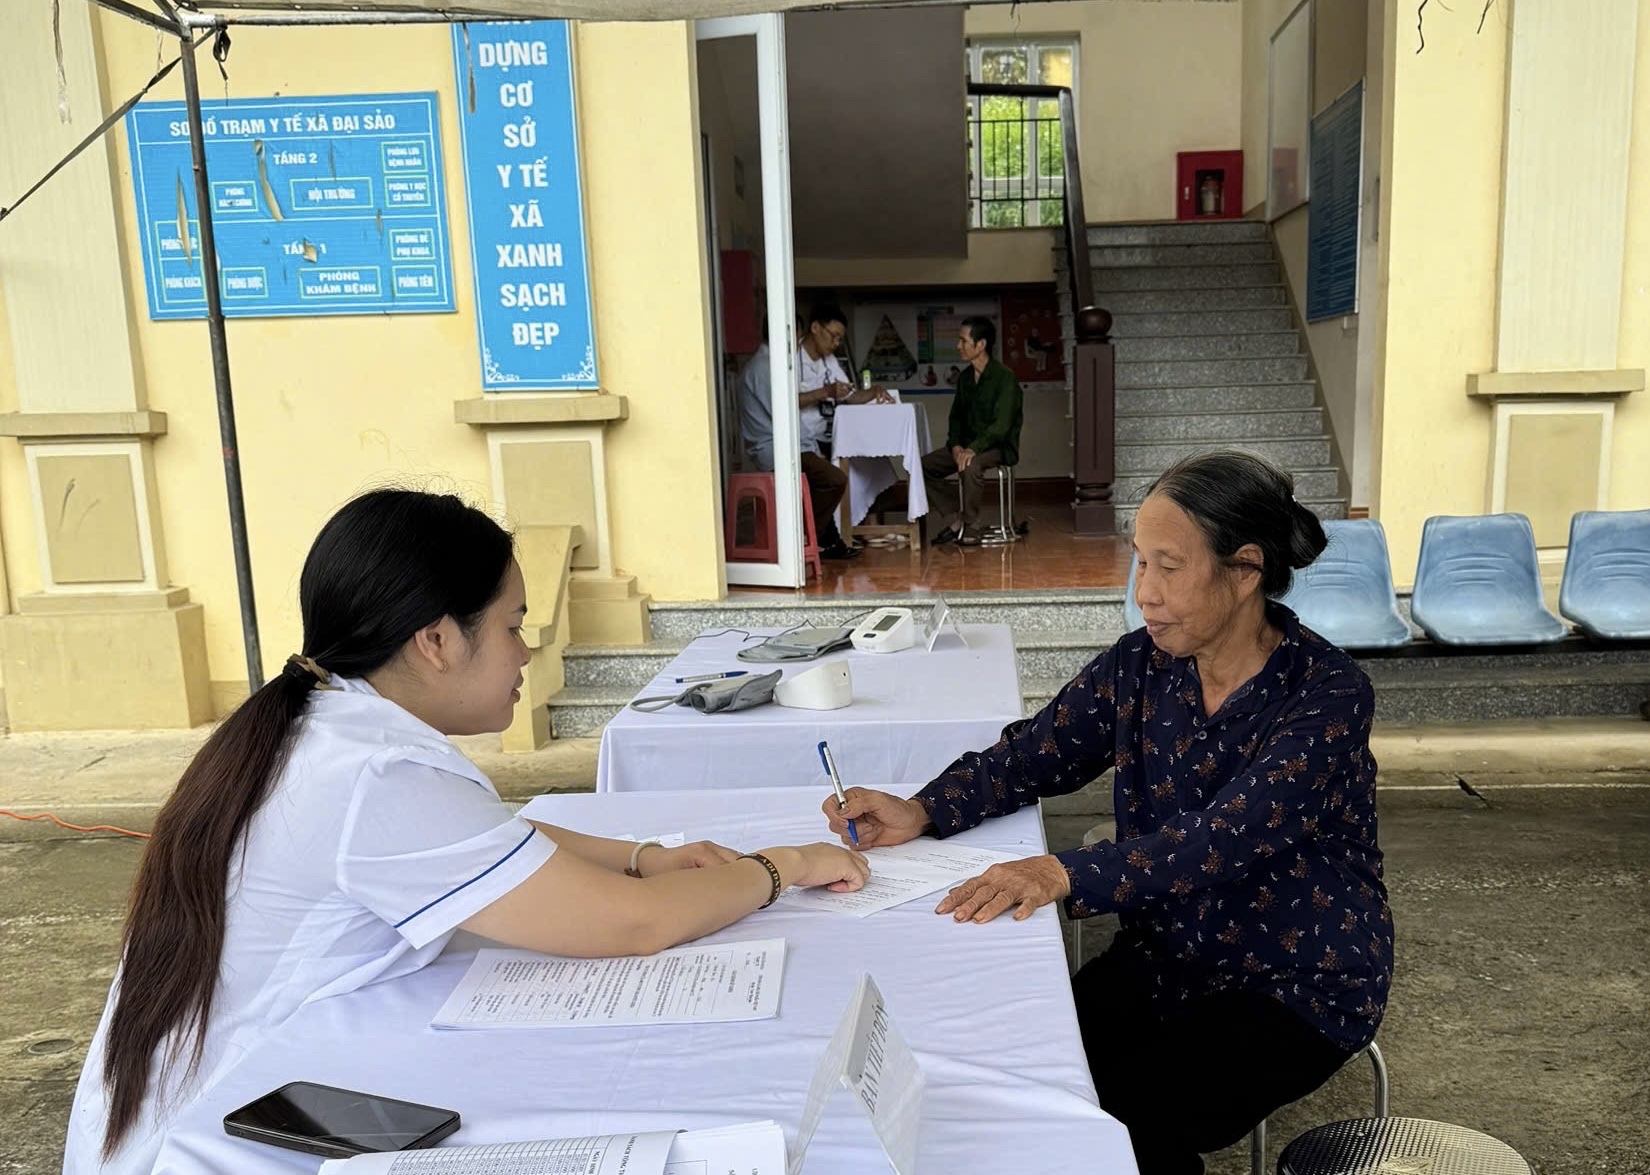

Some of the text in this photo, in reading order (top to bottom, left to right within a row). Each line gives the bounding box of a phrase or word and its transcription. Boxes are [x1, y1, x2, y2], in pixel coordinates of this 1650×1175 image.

[478, 40, 548, 72] DỰNG
[500, 80, 534, 108] CƠ
[220, 119, 266, 137] TRẠM
[269, 118, 279, 133] Y
[283, 112, 303, 132] TẾ
[306, 114, 328, 132] XÃ
[332, 115, 360, 134] ĐẠI
[363, 109, 395, 130] SẢO
[503, 115, 536, 148] SỞ
[309, 152, 318, 164] 2
[496, 155, 549, 188] Y TẾ
[509, 199, 544, 228] XÃ
[495, 243, 563, 267] XANH
[306, 282, 377, 295] KHÁM BỆNH
[319, 270, 360, 282] PHÒNG
[500, 283, 567, 312] SẠCH
[512, 322, 560, 351] ĐẸP
